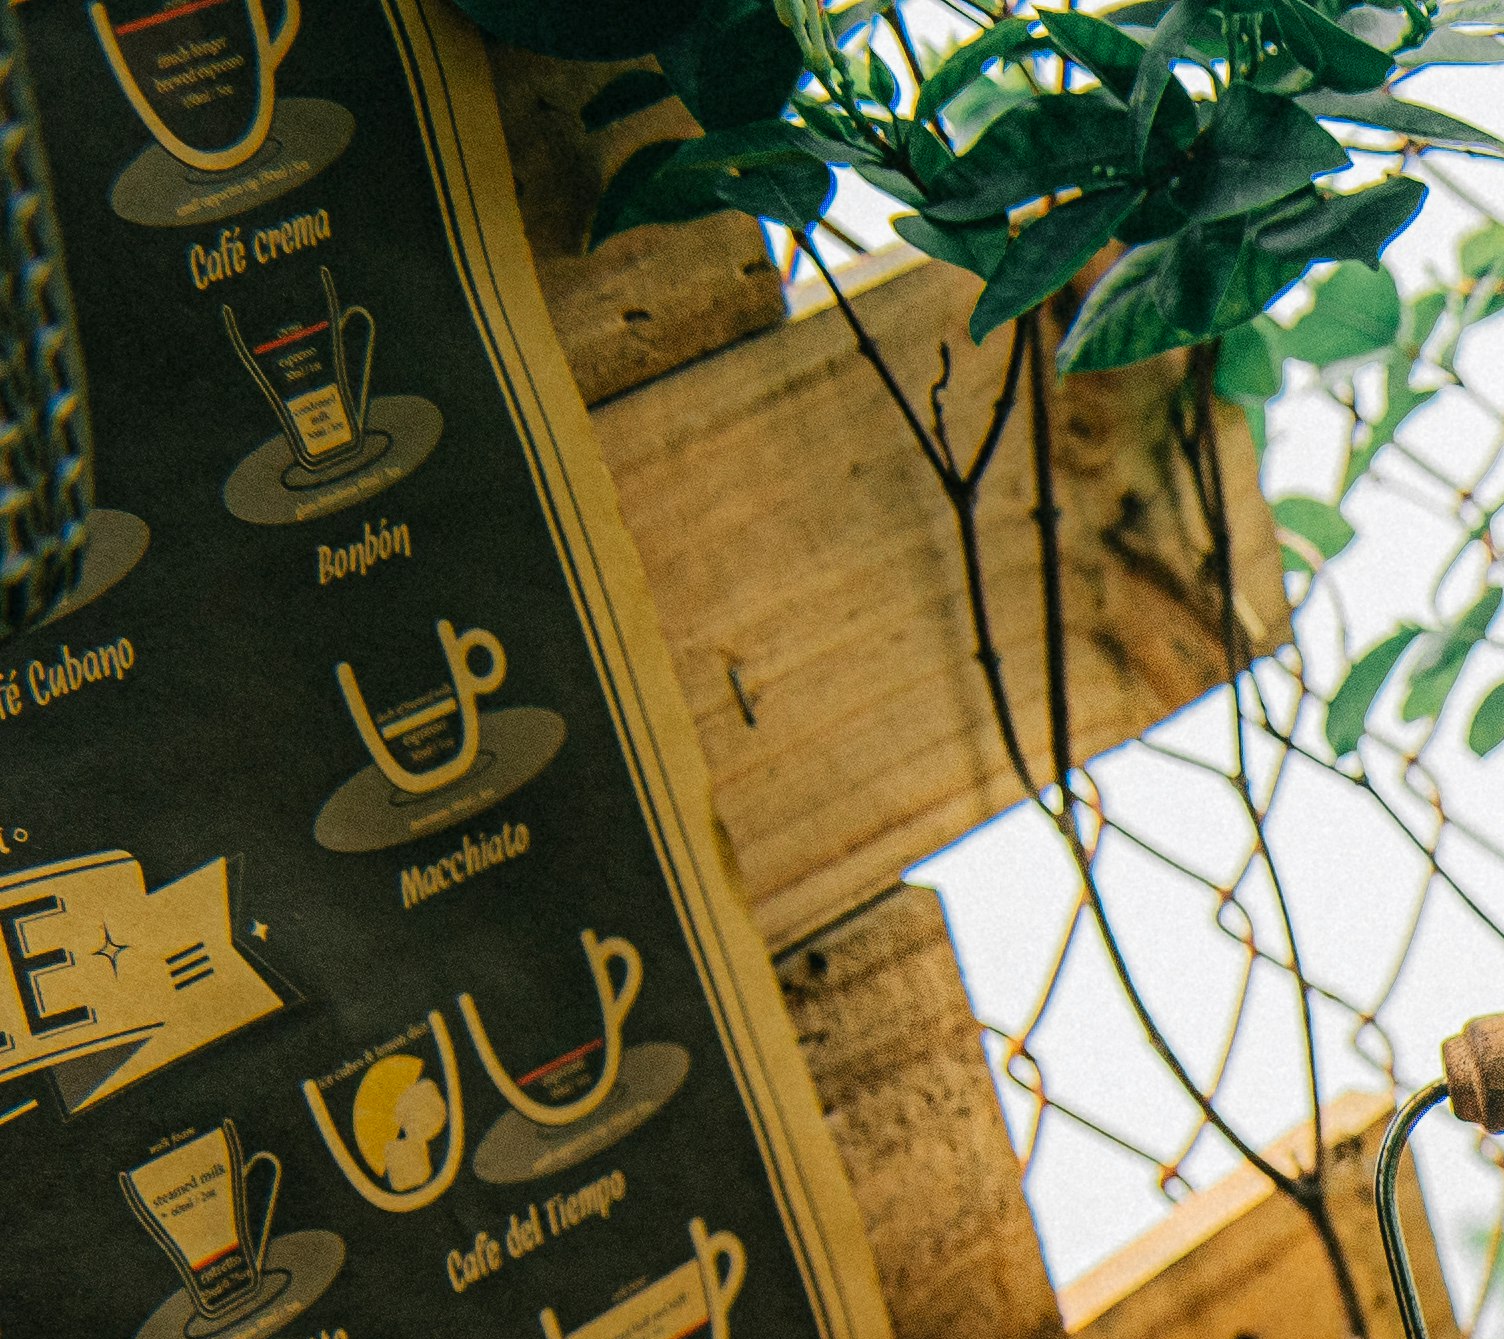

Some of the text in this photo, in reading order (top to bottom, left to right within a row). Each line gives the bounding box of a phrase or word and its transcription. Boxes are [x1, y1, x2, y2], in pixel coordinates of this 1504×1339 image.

[190, 208, 332, 291] Café crema
[318, 518, 412, 586] Bonbón
[29, 636, 135, 706] Cubano
[401, 821, 531, 910] Macchiato
[507, 1203, 544, 1258] del
[545, 1169, 626, 1238] Tiempo
